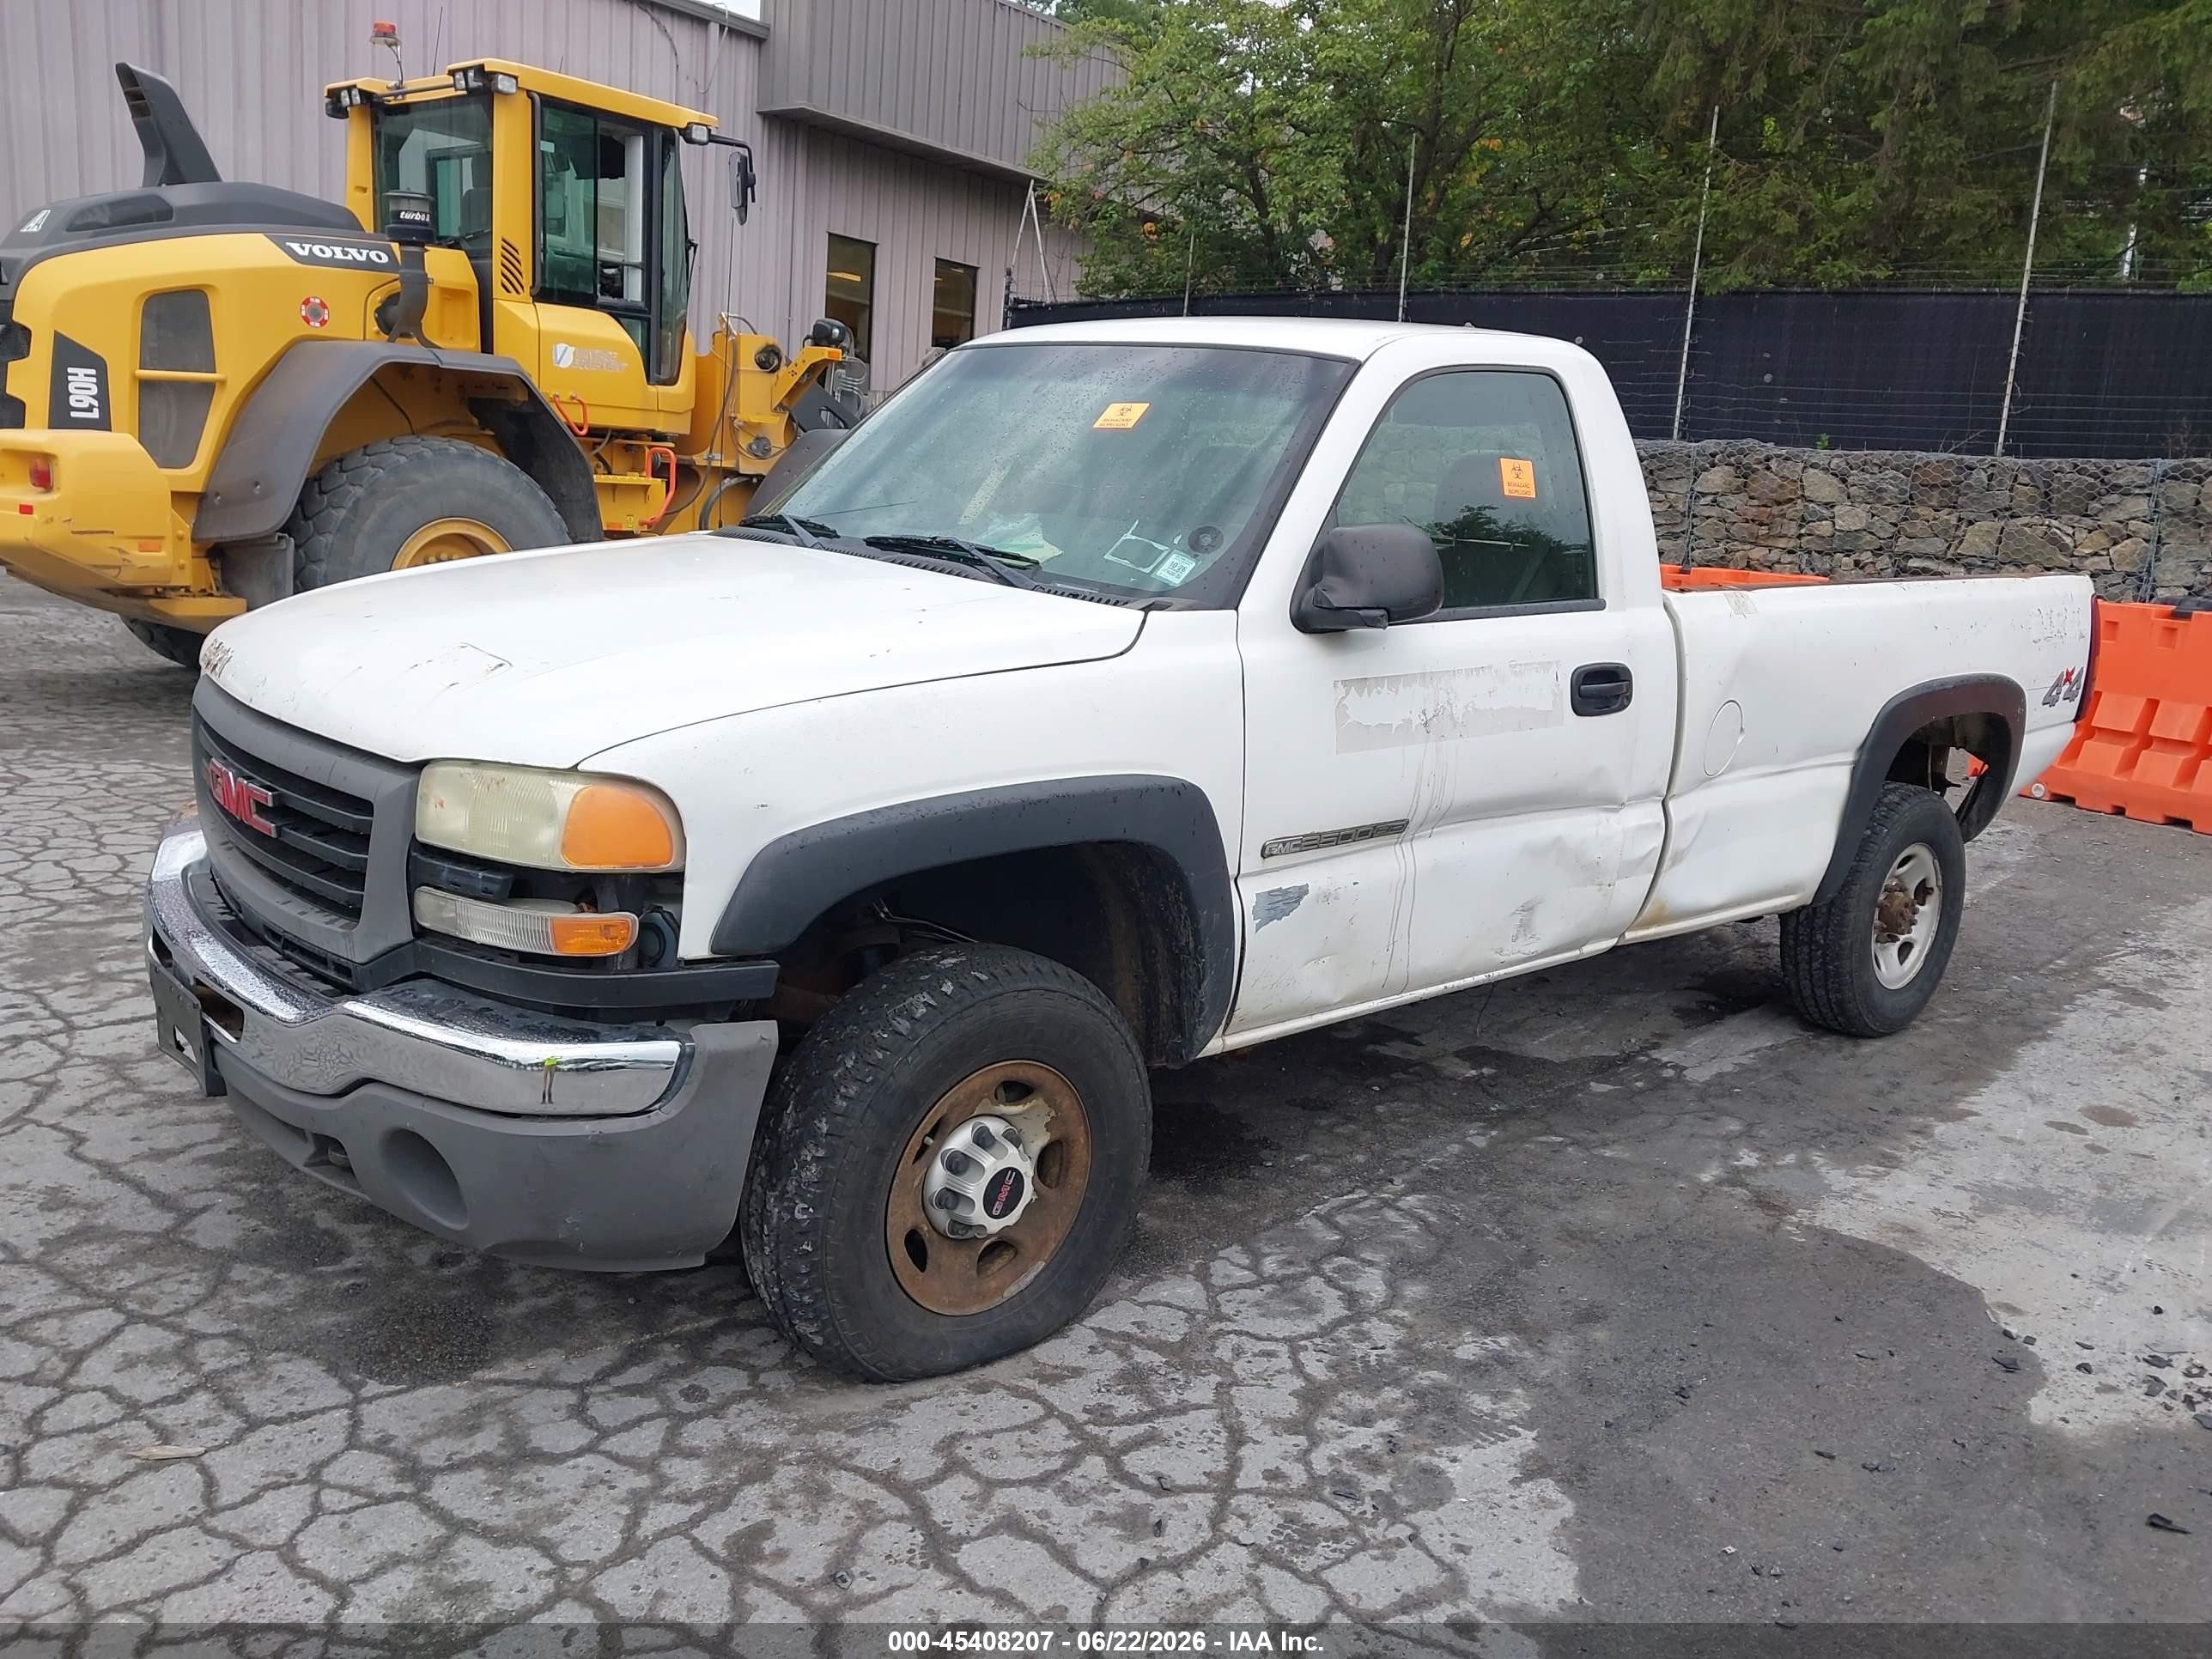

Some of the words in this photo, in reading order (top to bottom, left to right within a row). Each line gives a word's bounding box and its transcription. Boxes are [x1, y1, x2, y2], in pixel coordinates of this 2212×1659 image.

[285, 241, 389, 264] VOLVO
[67, 367, 100, 419] L90H
[210, 757, 276, 838] GMC
[992, 1170, 1016, 1216] GMC
